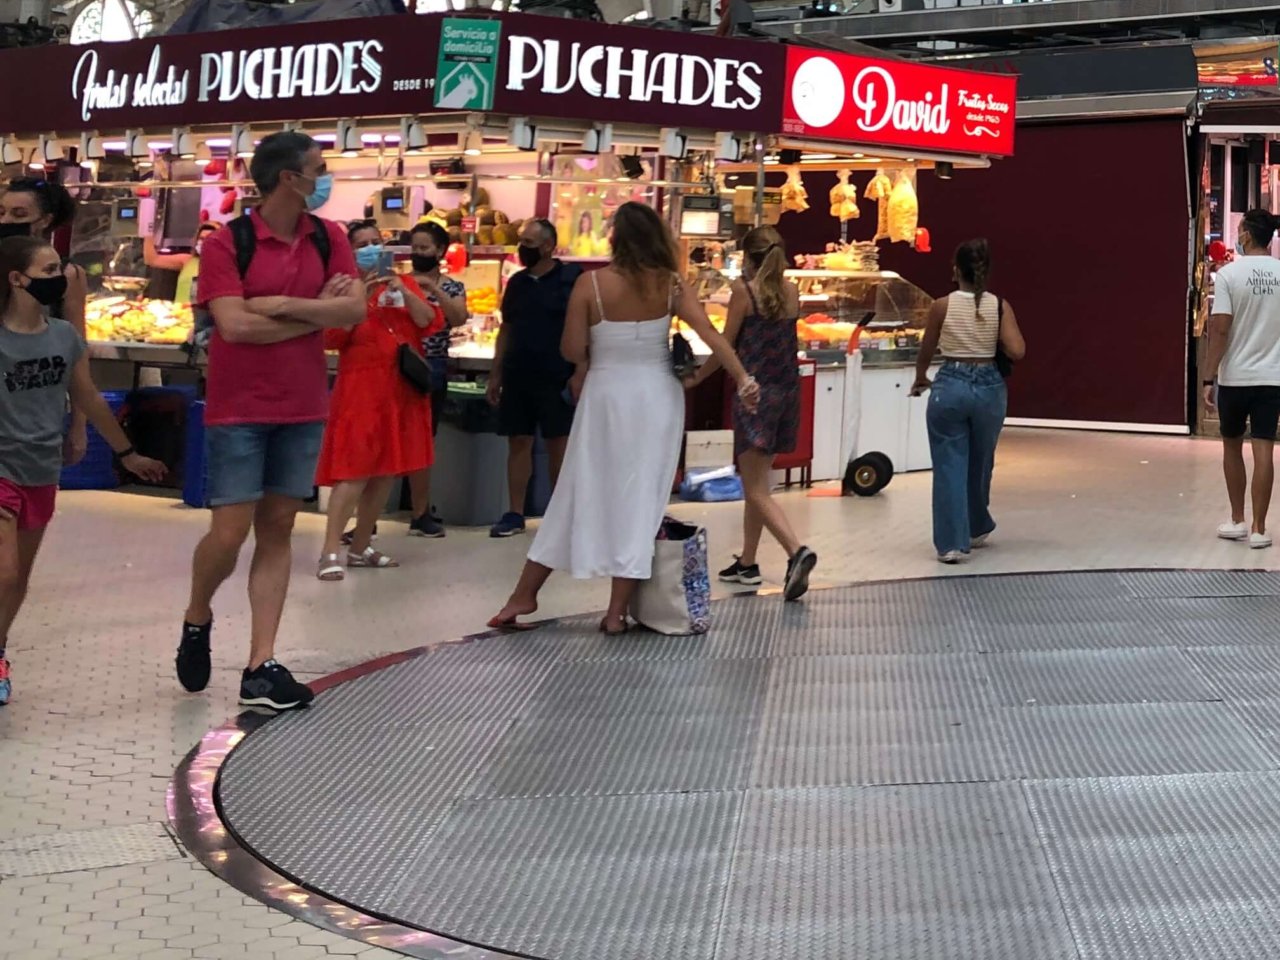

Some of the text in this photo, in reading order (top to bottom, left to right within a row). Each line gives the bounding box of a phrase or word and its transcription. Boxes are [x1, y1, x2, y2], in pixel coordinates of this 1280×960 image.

[443, 26, 487, 40] Servicio
[72, 40, 383, 122] Frutas selectas PUCHADES
[393, 79, 421, 91] DESDE
[506, 35, 762, 110] PUCHADES
[852, 66, 950, 135] David
[1252, 269, 1274, 278] Nice
